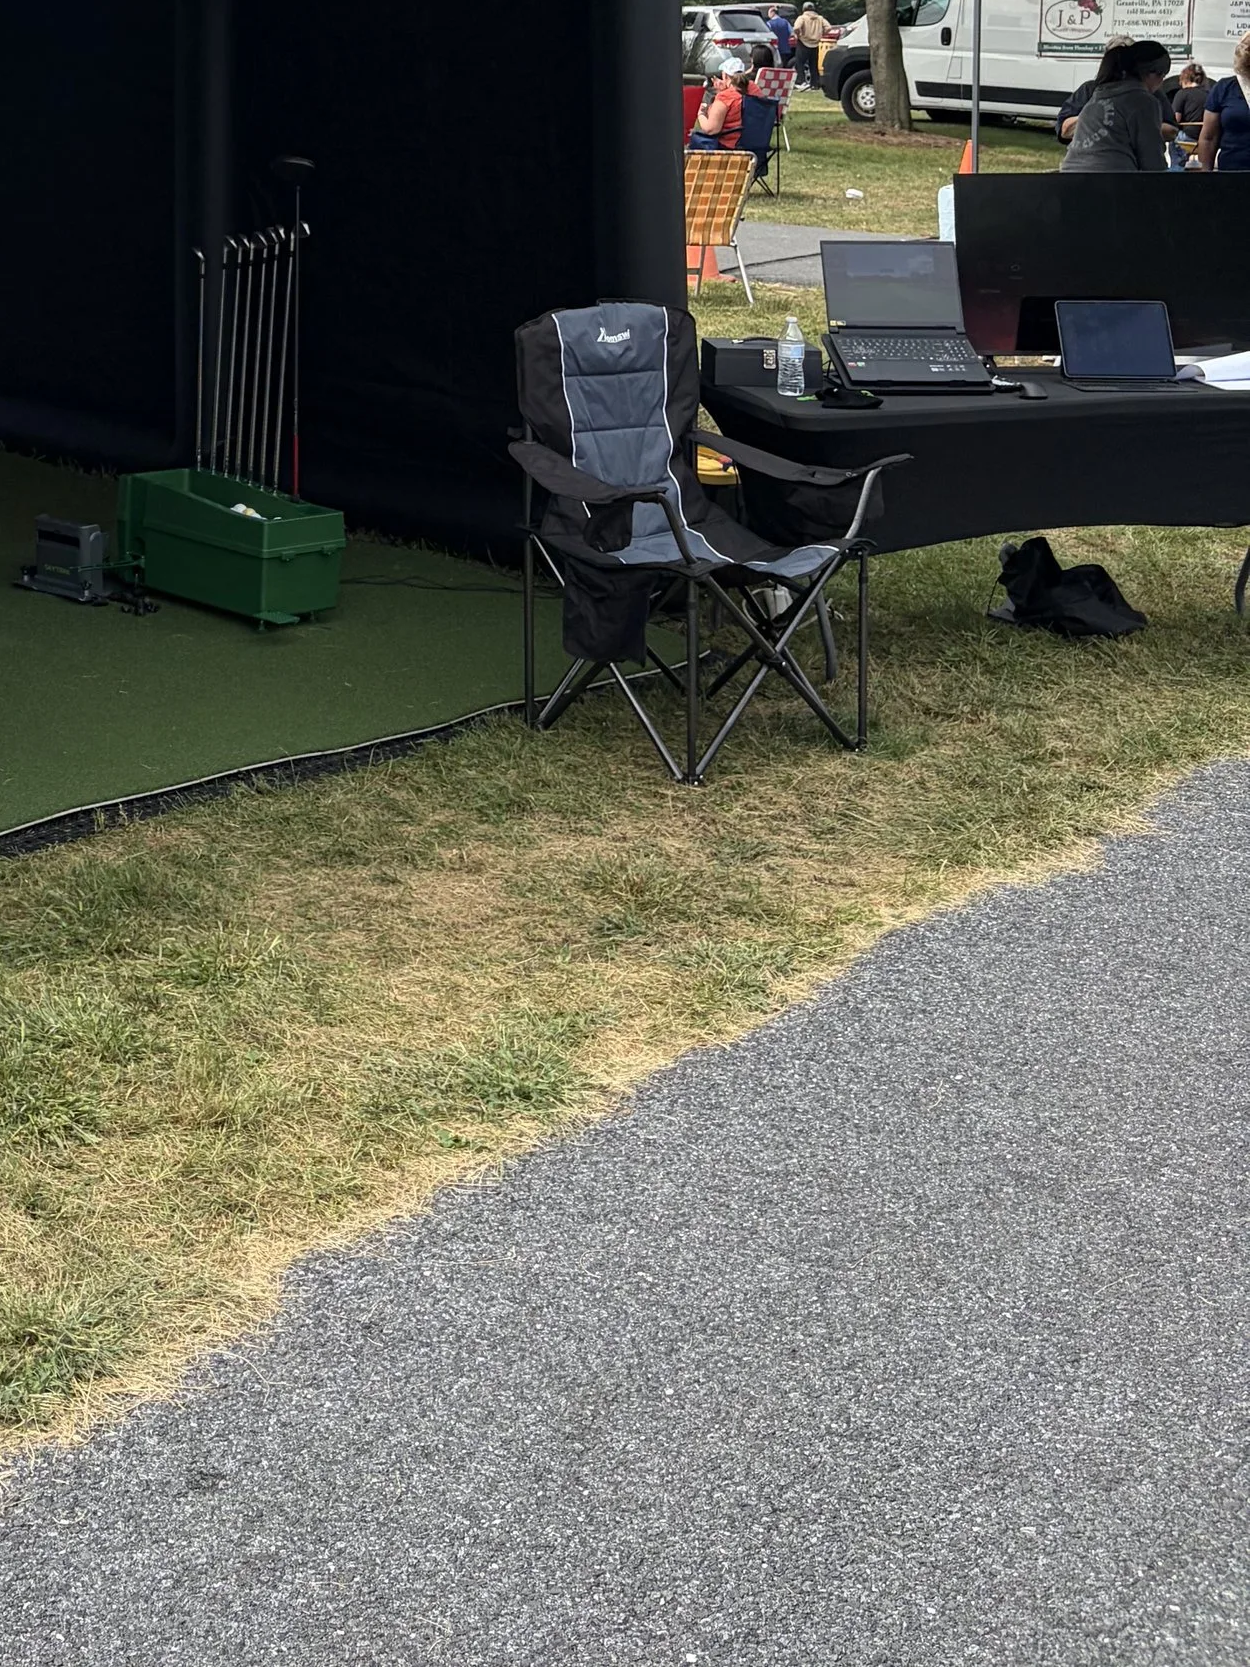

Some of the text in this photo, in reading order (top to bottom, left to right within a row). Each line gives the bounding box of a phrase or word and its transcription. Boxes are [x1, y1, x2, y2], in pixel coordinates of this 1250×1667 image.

[1056, 9, 1090, 27] J & P
